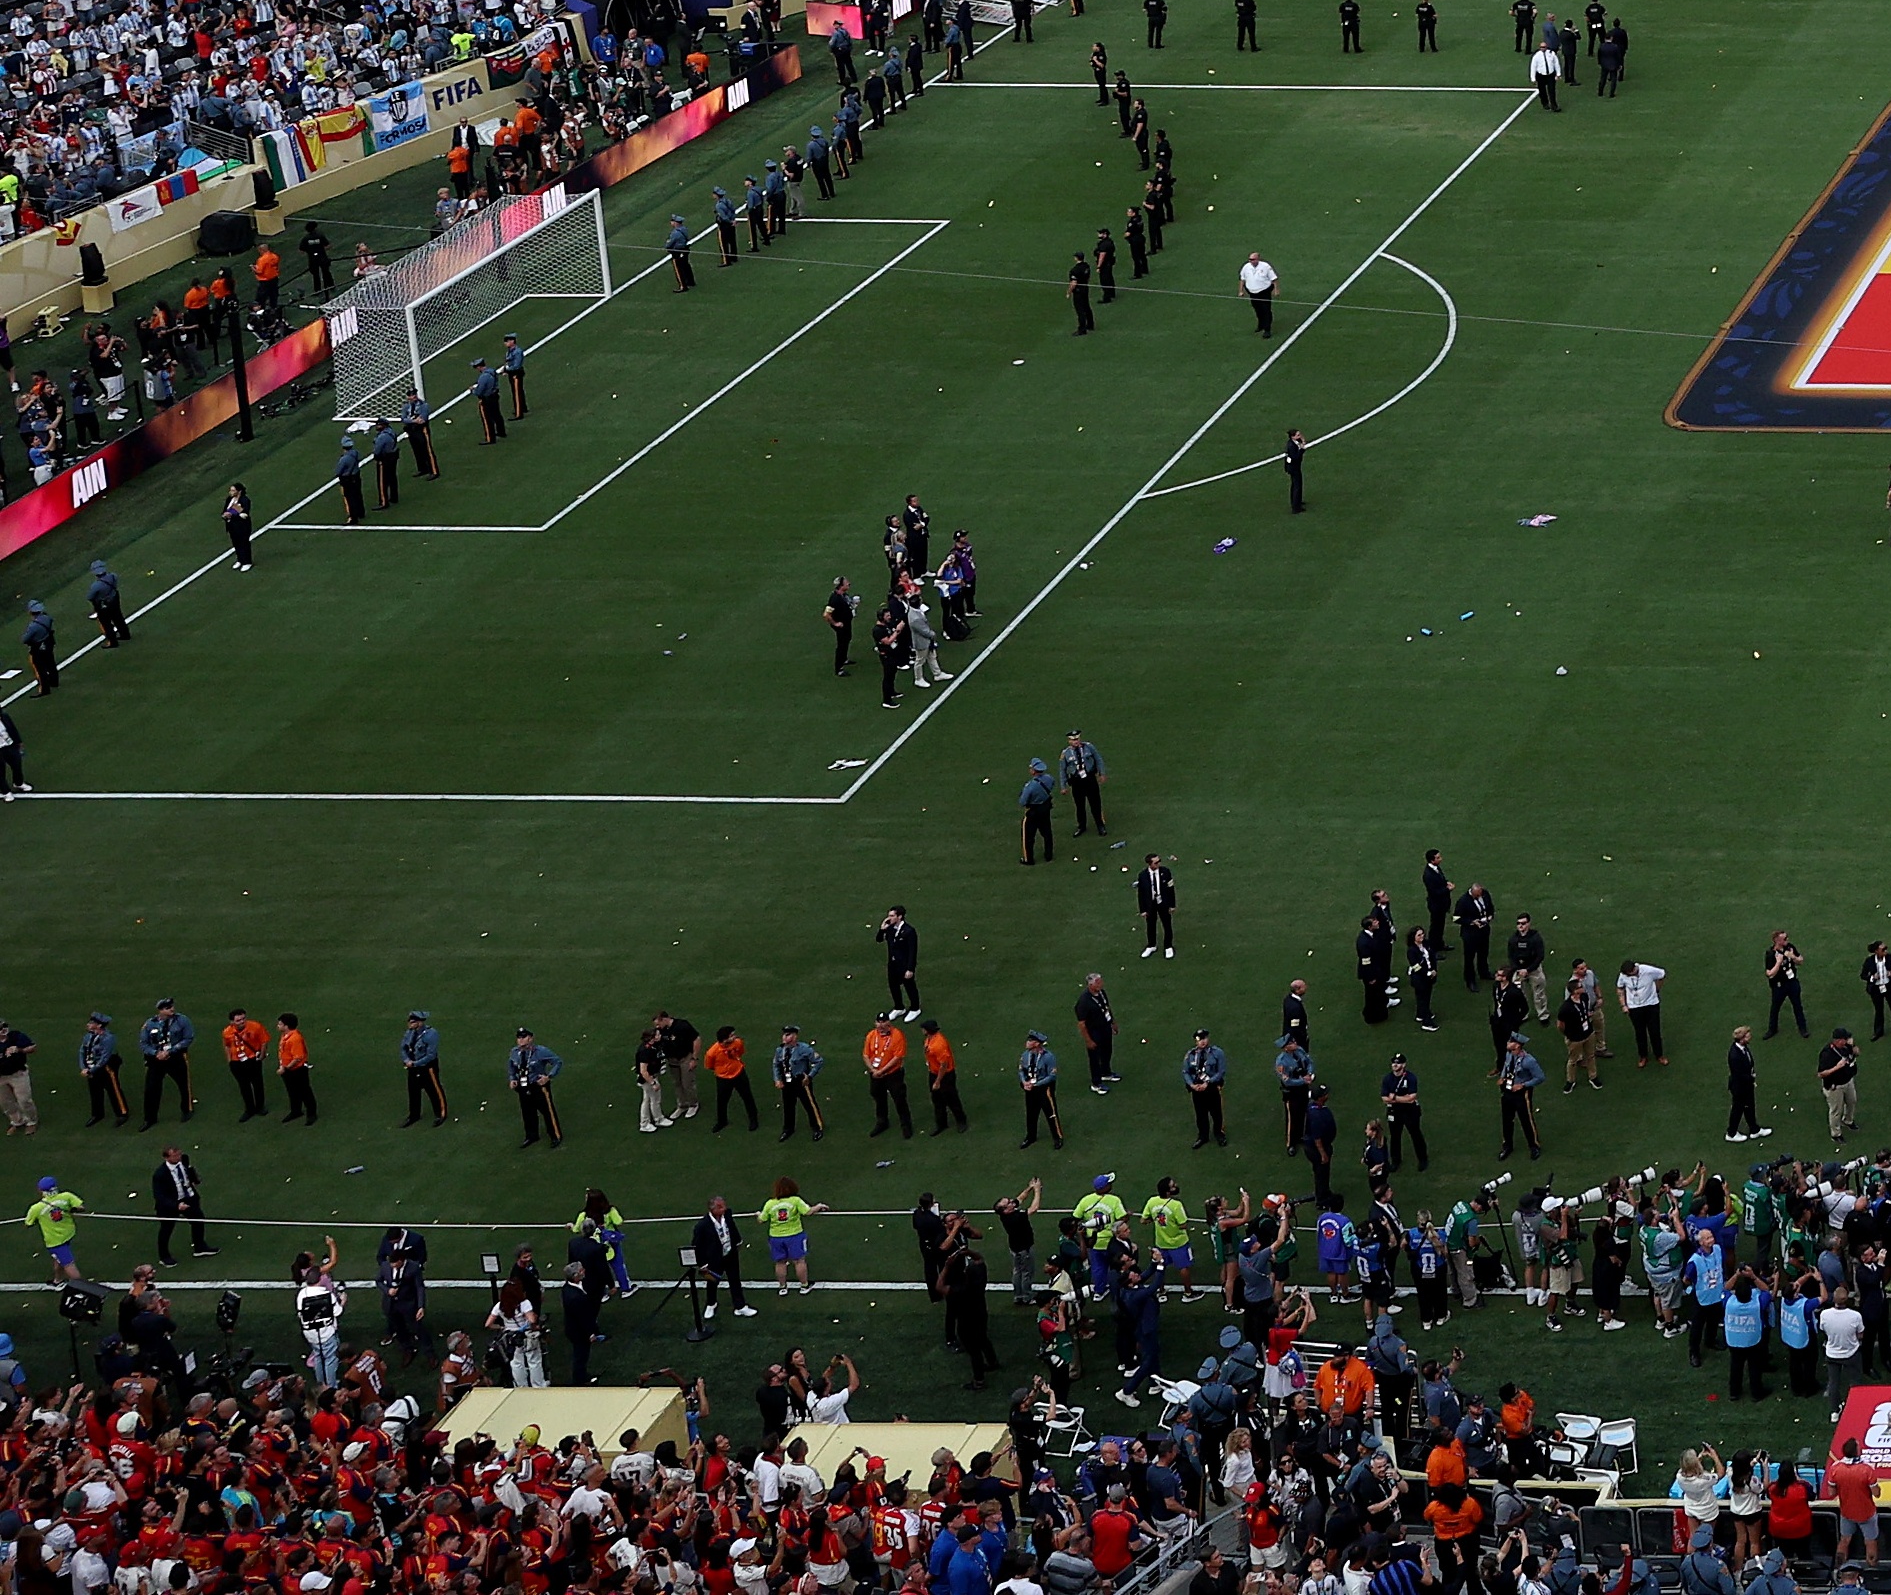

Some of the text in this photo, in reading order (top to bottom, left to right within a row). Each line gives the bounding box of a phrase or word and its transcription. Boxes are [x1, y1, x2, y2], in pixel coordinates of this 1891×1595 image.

[432, 75, 483, 110] FIFA
[728, 78, 749, 112] AIN
[330, 306, 358, 347] AIN
[72, 458, 107, 508] AIN
[1726, 1316, 1754, 1325] FIFA
